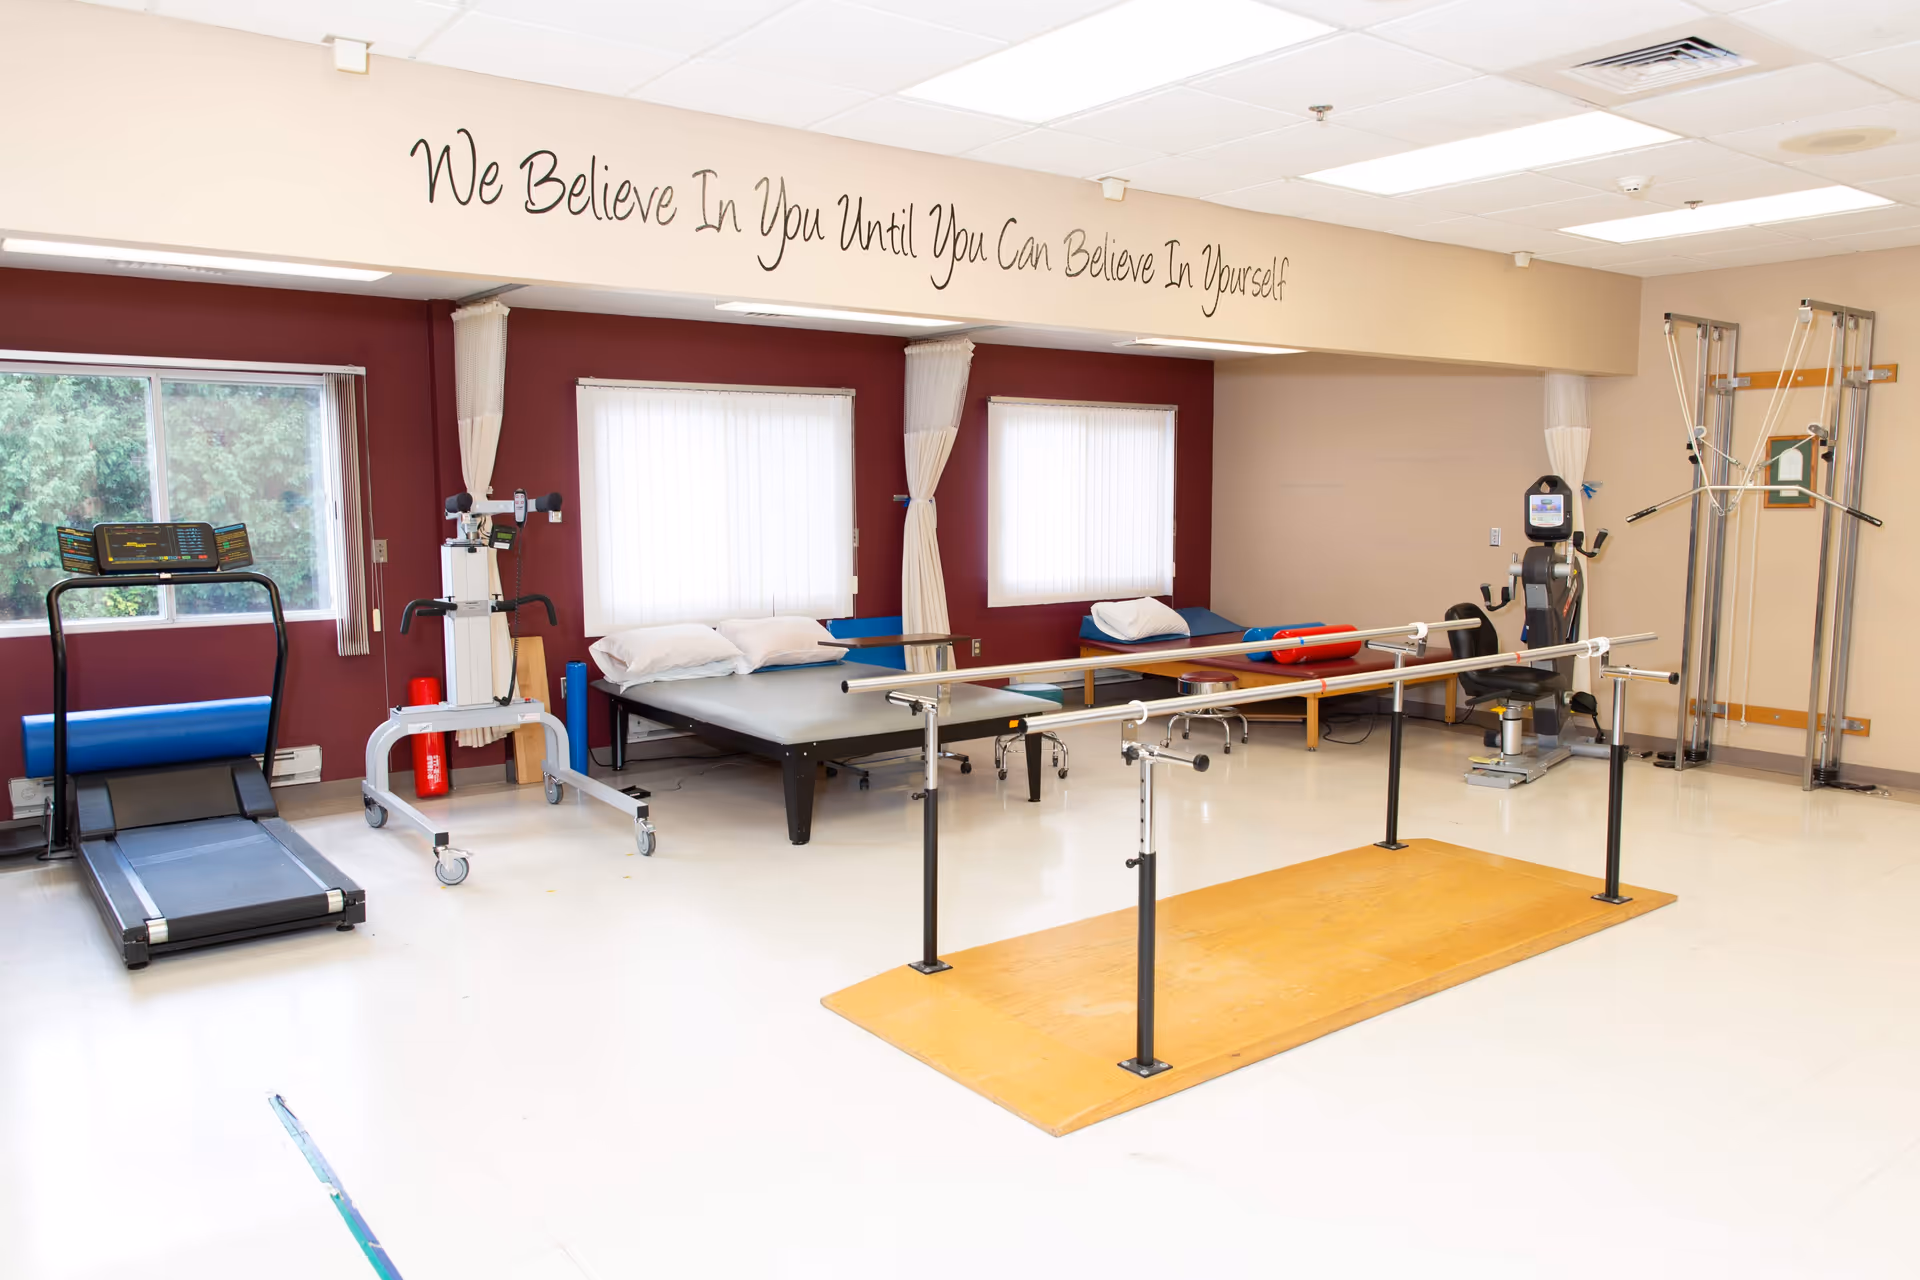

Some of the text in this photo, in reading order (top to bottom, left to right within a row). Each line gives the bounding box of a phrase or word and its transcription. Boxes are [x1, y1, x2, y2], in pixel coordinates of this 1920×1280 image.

[410, 128, 1289, 318] We Believe In You Until You Can Believe In Yourself
